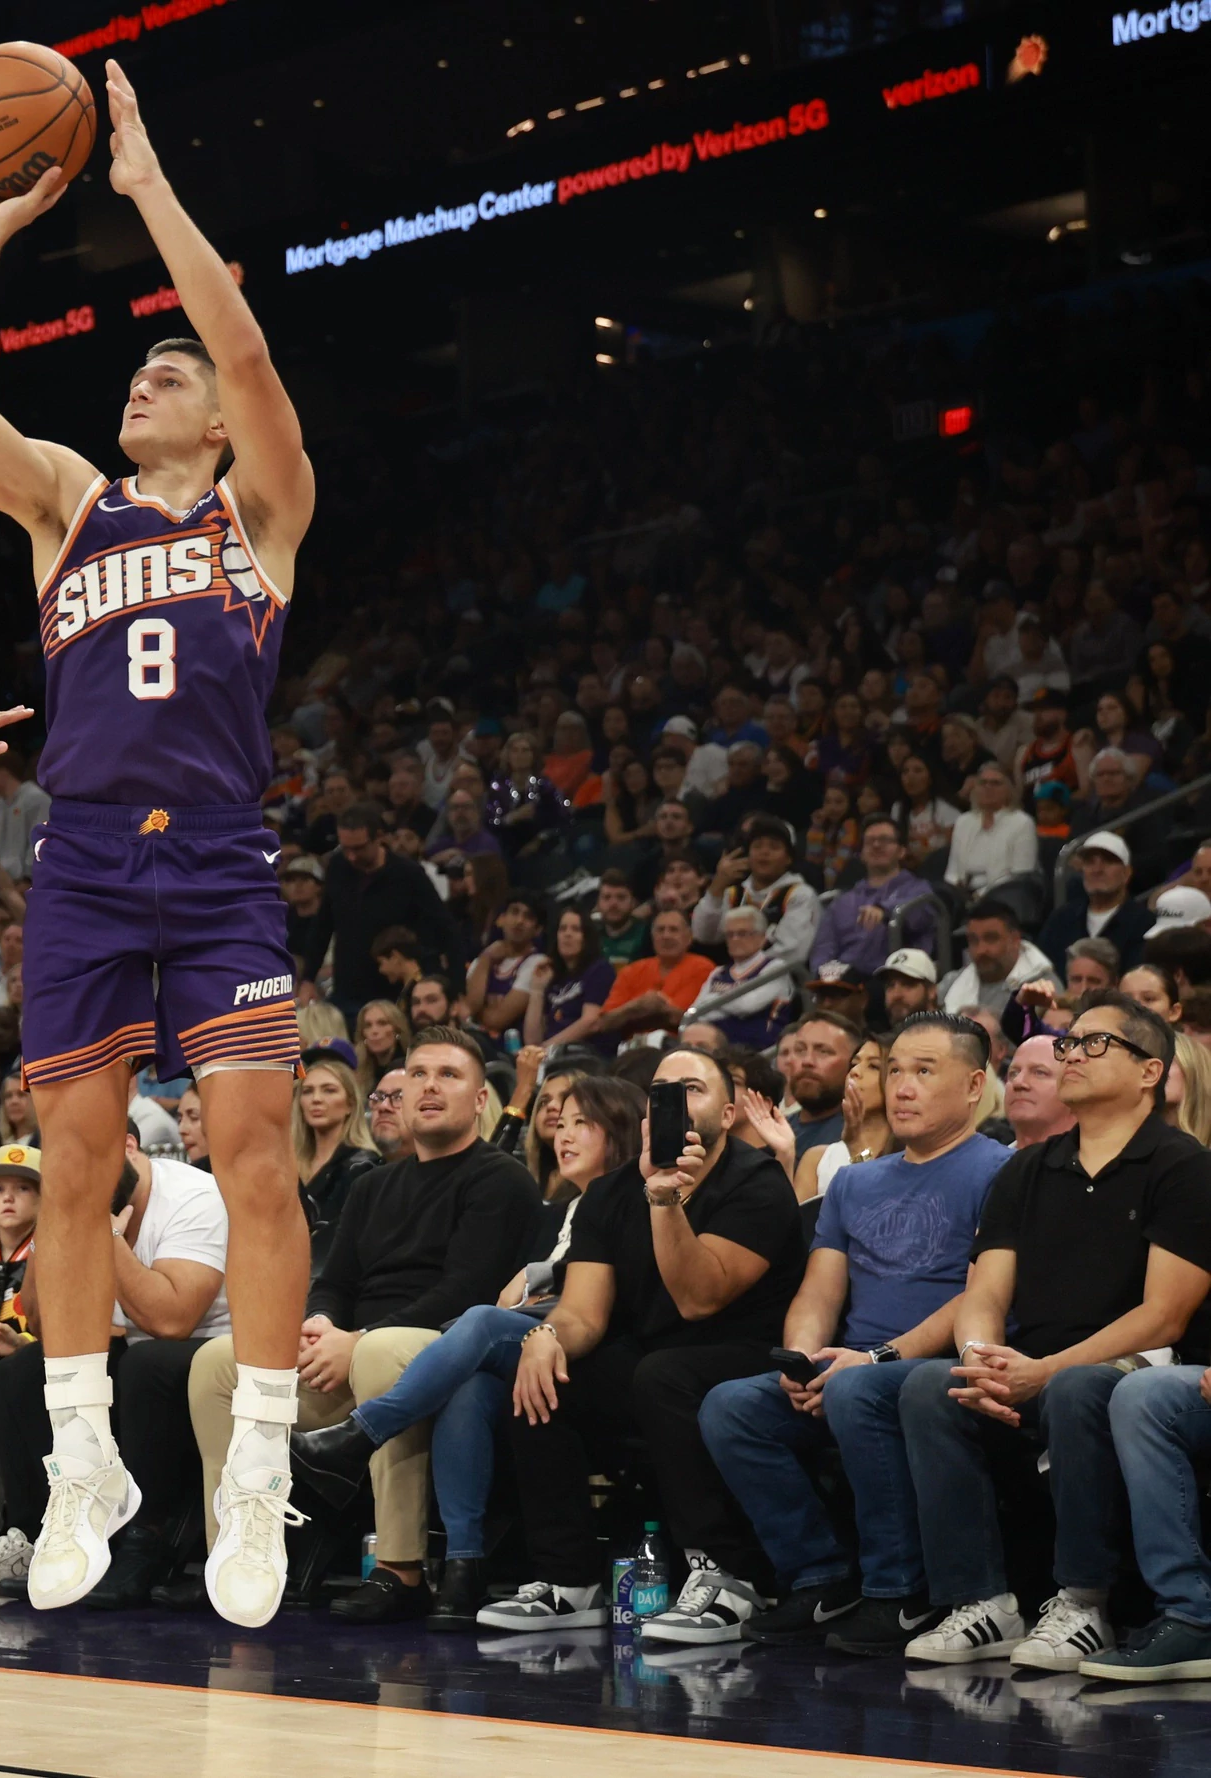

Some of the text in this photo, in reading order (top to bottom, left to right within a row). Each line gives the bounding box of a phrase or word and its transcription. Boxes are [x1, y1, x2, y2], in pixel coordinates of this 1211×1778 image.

[1111, 0, 1211, 46] Mortga
[882, 62, 980, 109] verizon
[285, 97, 830, 274] Mortgage Matchup Center powered by Verizon 5G
[0, 320, 65, 354] Verizon
[64, 305, 96, 337] 5G
[57, 536, 214, 641] SUNS
[127, 618, 177, 701] 8
[637, 1588, 668, 1610] DASA
